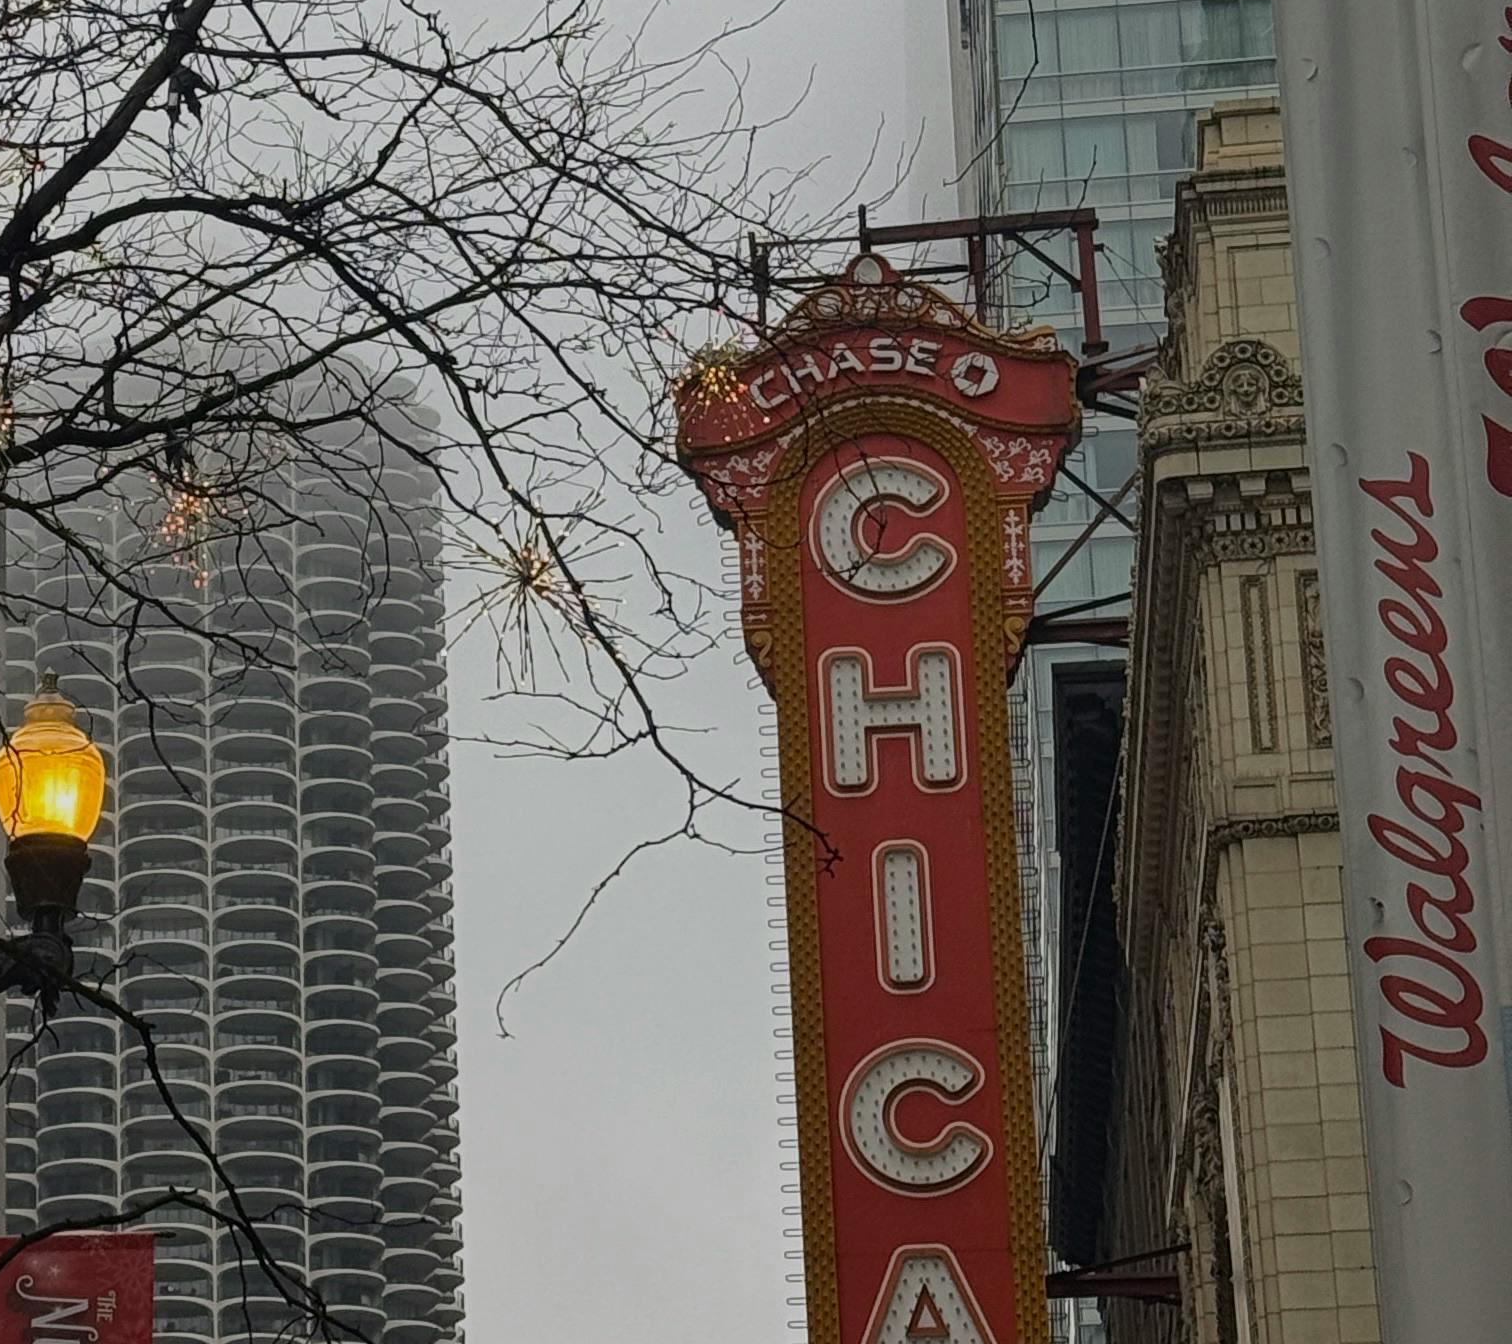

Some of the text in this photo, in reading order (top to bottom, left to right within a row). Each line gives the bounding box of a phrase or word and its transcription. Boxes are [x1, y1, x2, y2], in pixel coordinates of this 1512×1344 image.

[749, 336, 941, 415] CHASE
[1357, 449, 1490, 1091] Walgreens
[97, 1289, 117, 1323] THE
